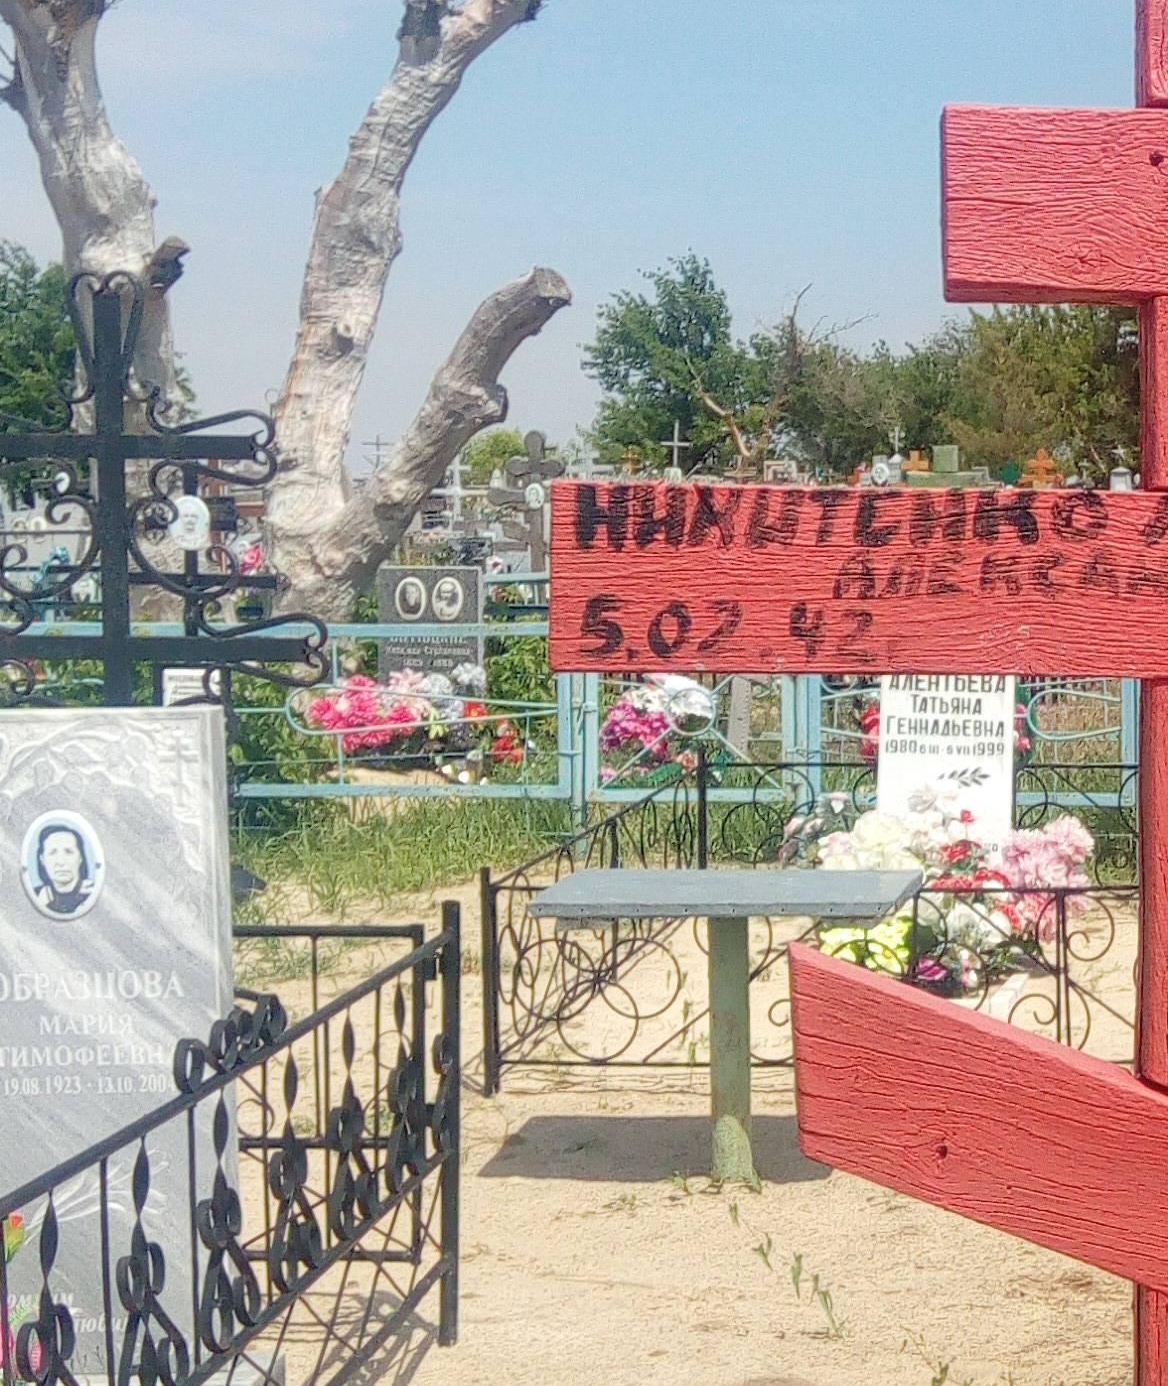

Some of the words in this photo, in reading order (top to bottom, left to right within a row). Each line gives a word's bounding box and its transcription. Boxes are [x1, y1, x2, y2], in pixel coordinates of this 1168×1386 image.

[911, 694, 982, 715] ТАТЬЯНА
[886, 716, 1005, 737] ГЕННАДЬЕВНА
[885, 739, 917, 753] 1980
[972, 742, 1004, 756] 1999
[39, 1013, 135, 1035] МАРИЯ
